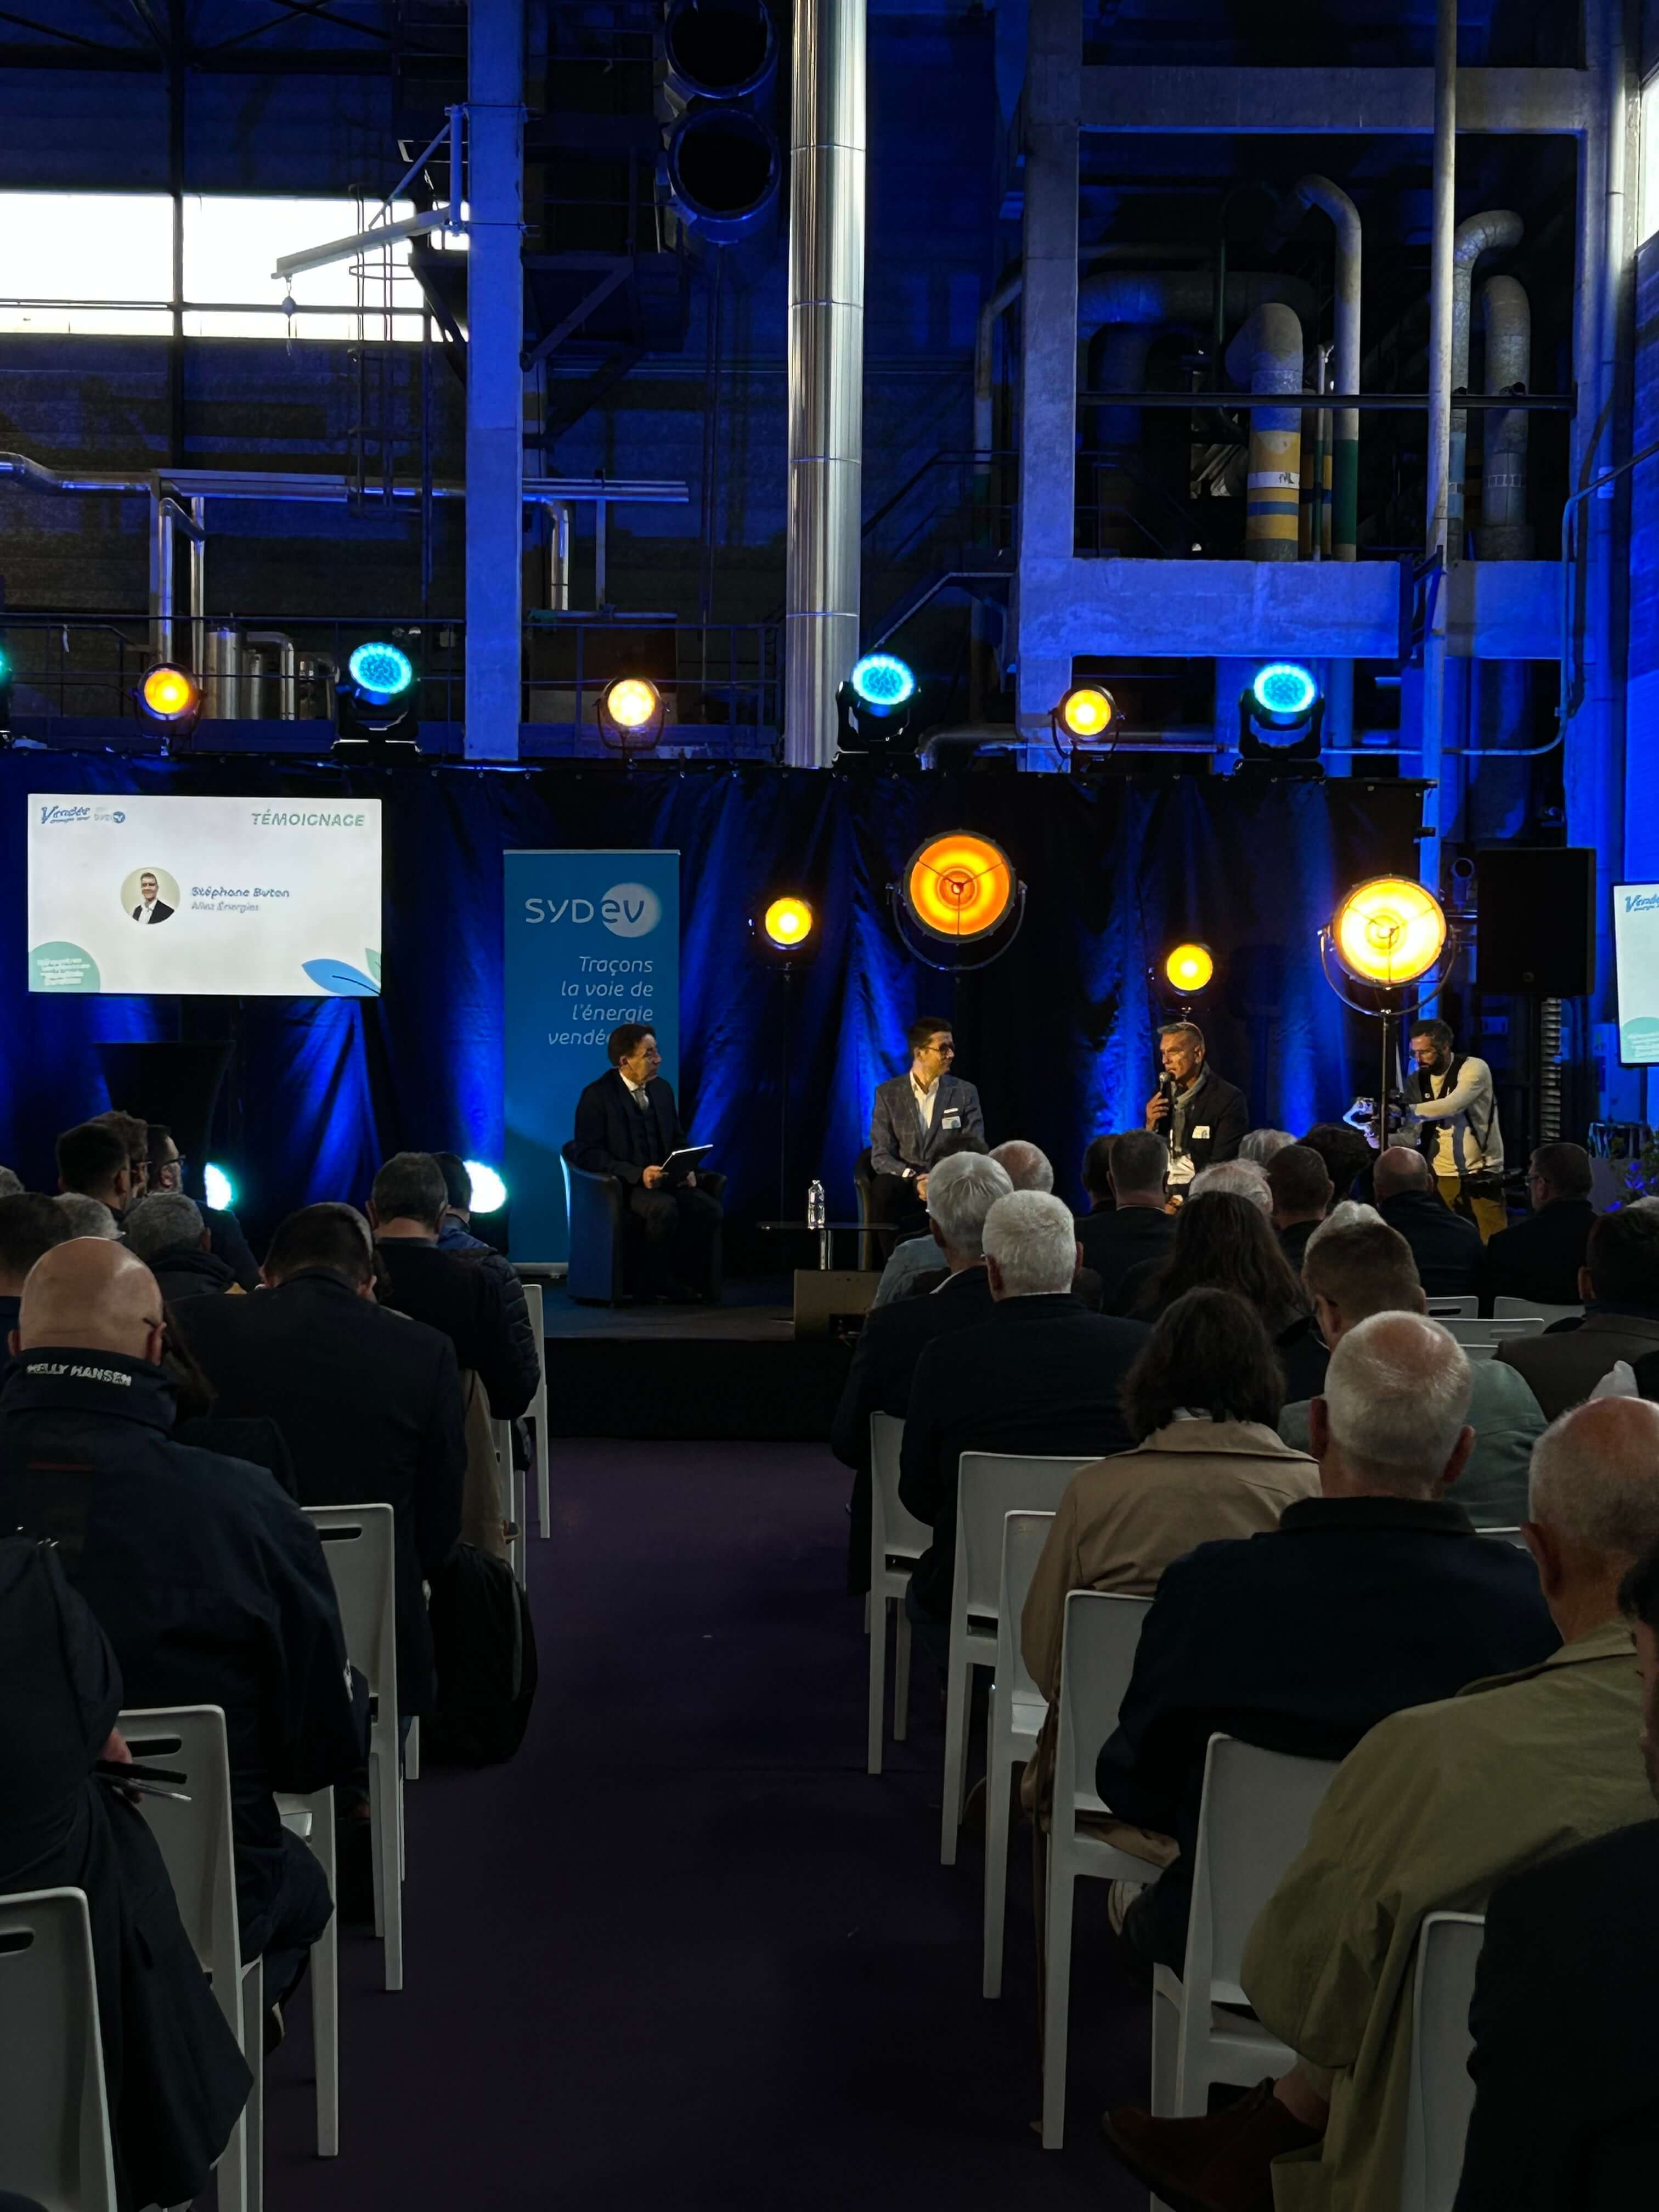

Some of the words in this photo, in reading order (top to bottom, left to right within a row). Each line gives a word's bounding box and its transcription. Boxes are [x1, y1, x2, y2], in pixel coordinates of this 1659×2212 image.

[251, 809, 365, 826] TÉMOIGNAGE
[191, 887, 250, 900] Stéphane
[579, 956, 654, 977] Traçons
[561, 980, 580, 997] la
[585, 980, 625, 997] voie
[630, 980, 654, 997] de
[572, 1003, 654, 1024] l'énergie
[548, 1029, 610, 1045] vendé
[70, 1365, 132, 1387] HANSEN
